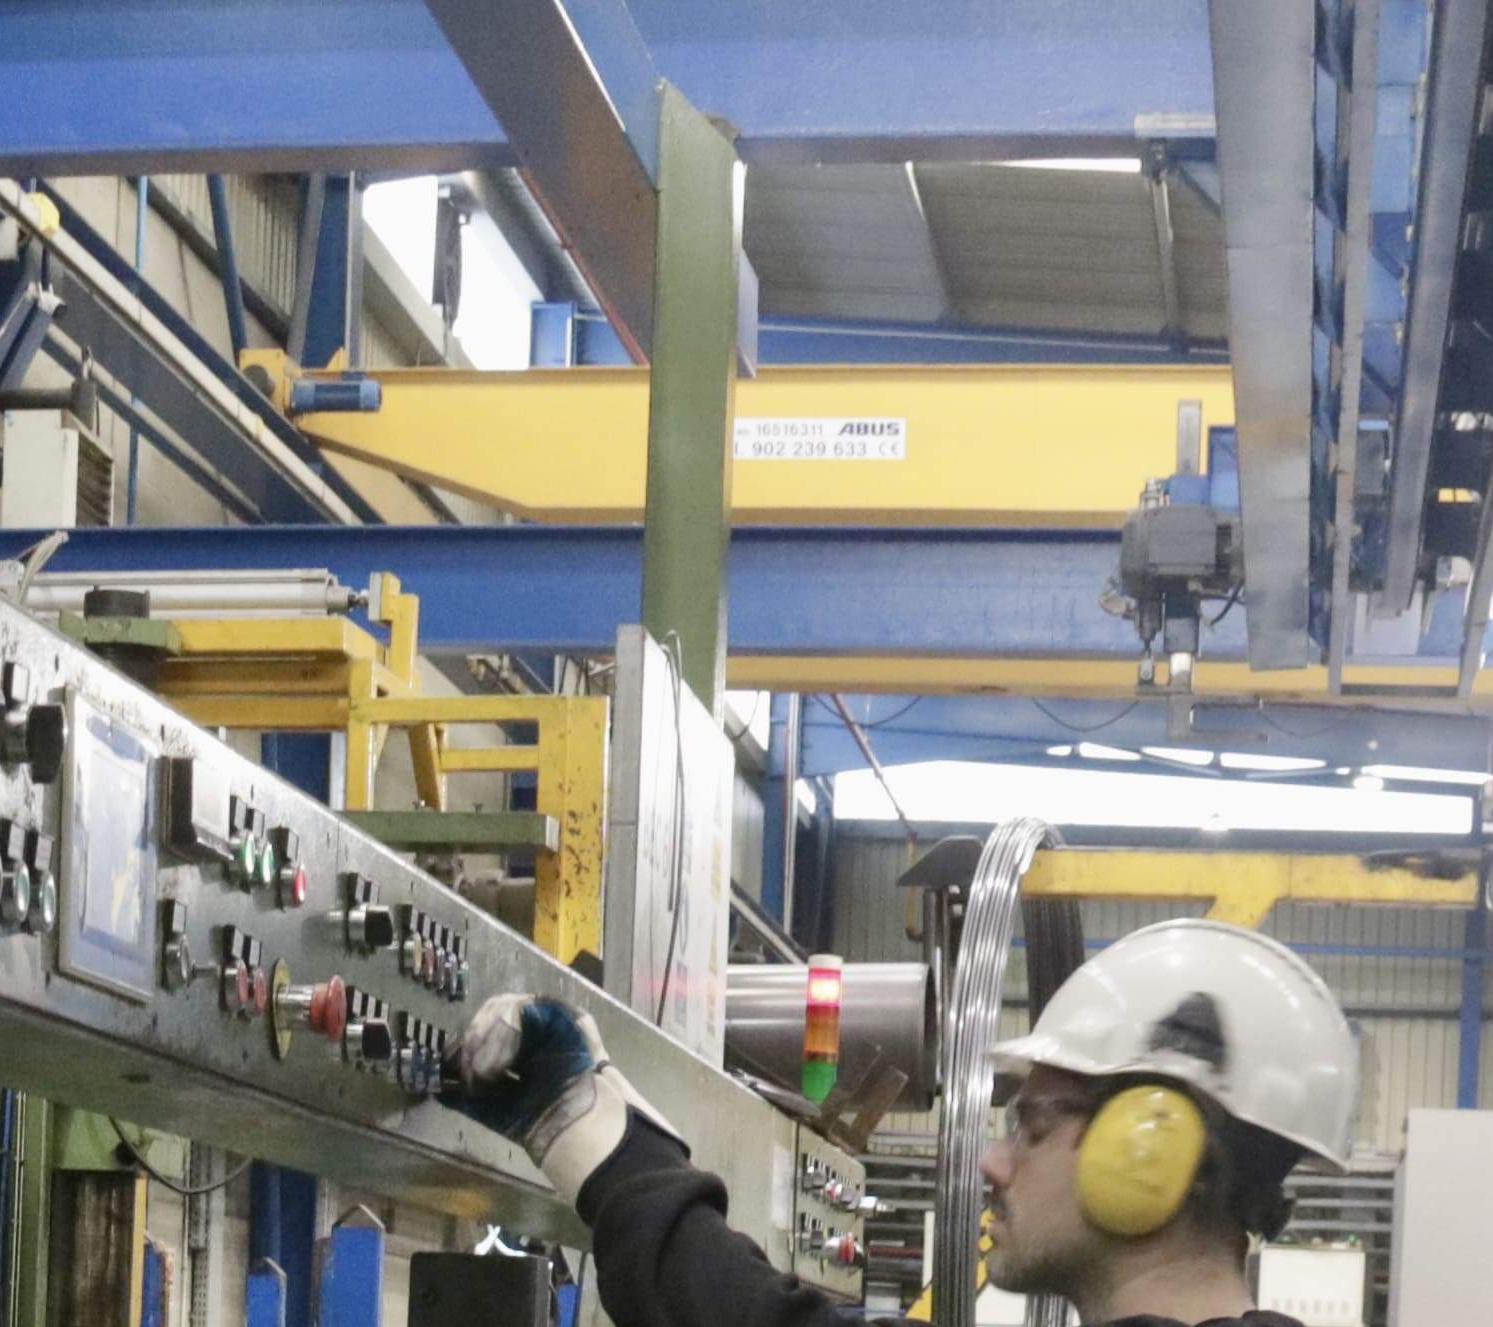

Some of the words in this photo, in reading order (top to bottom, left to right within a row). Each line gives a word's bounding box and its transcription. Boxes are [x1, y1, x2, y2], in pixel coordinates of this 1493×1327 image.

[838, 422, 900, 436] ABUS
[752, 442, 785, 456] 902
[793, 442, 826, 456] 239
[834, 442, 866, 456] 633
